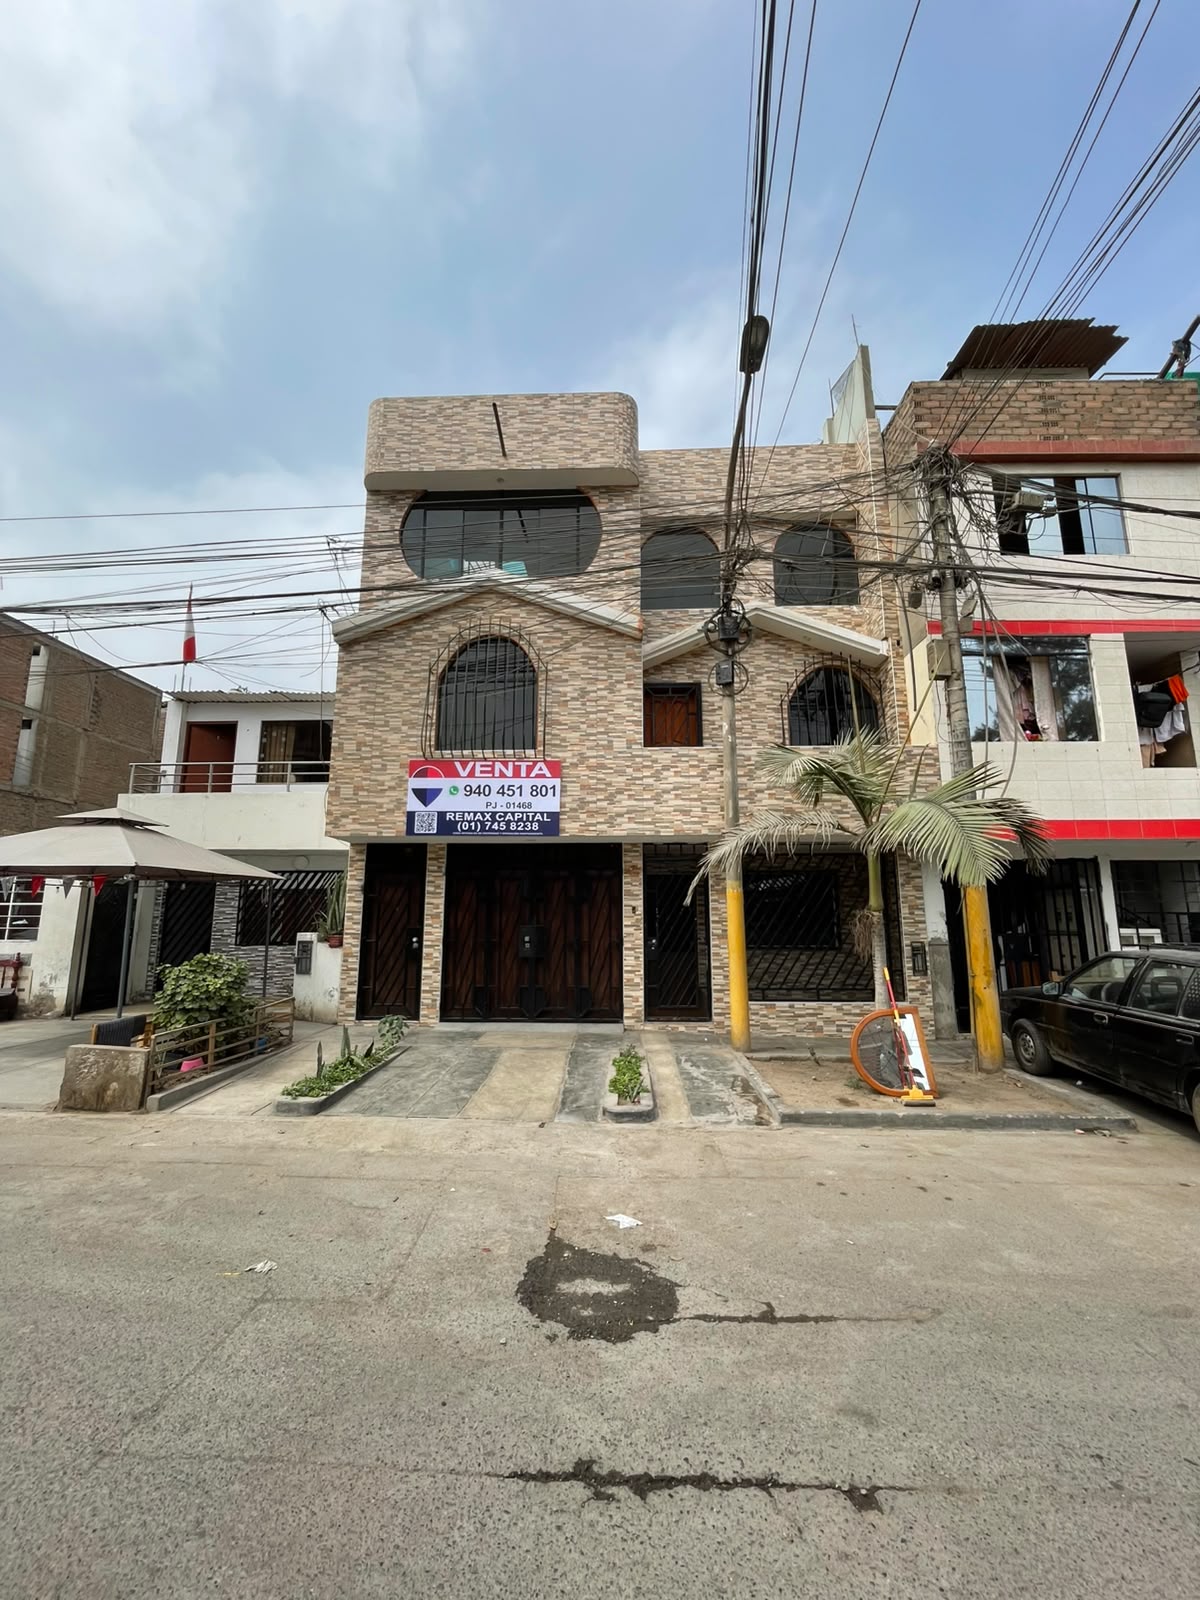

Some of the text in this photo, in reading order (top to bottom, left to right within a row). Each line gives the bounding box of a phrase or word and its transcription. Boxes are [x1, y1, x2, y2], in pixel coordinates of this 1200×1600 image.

[454, 761, 552, 777] VENTA
[463, 784, 556, 797] 940 451 801
[485, 801, 497, 810] PJ
[505, 801, 533, 810] 01468
[446, 812, 551, 821] REMAX CAPITAL
[457, 821, 539, 832] (01) 745 8238
